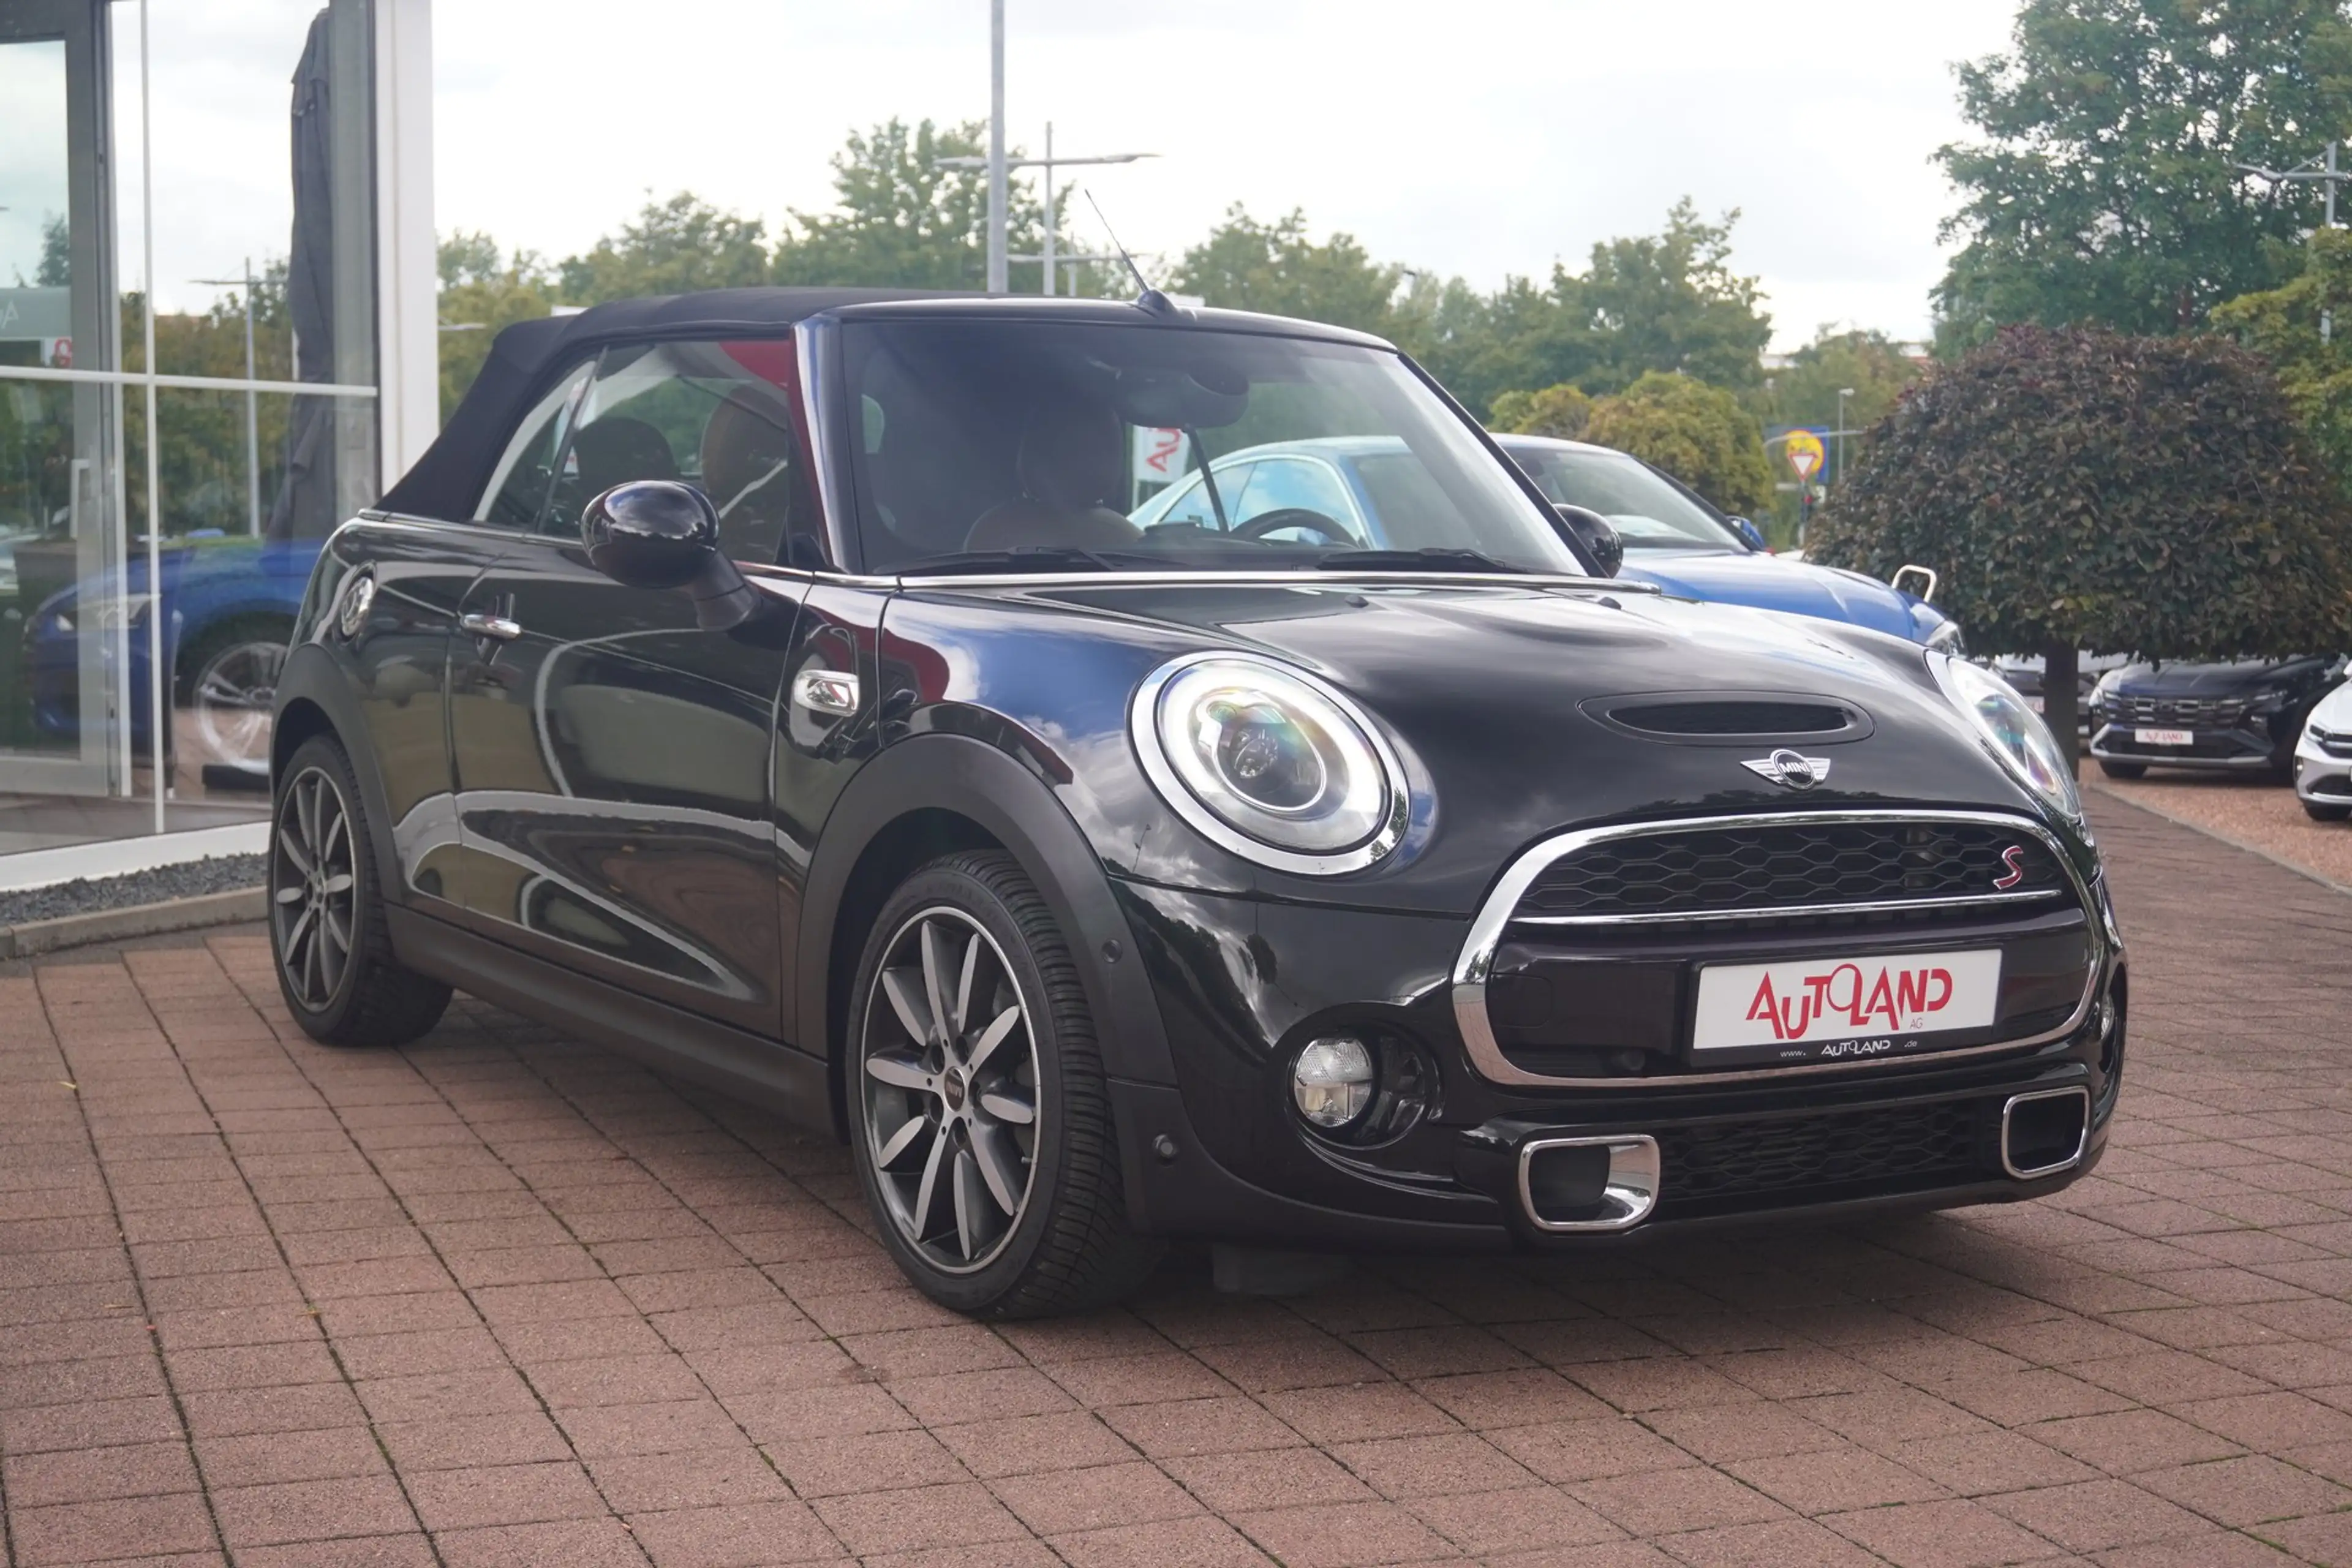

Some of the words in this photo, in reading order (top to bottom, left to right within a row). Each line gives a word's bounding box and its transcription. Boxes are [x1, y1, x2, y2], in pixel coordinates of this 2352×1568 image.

[1778, 761, 1811, 774] MINI
[1992, 845, 2024, 890] S
[1746, 963, 1953, 1040] AUTOLAND
[1910, 1017, 1924, 1030] AG
[1821, 1039, 1891, 1057] AUTOLAND
